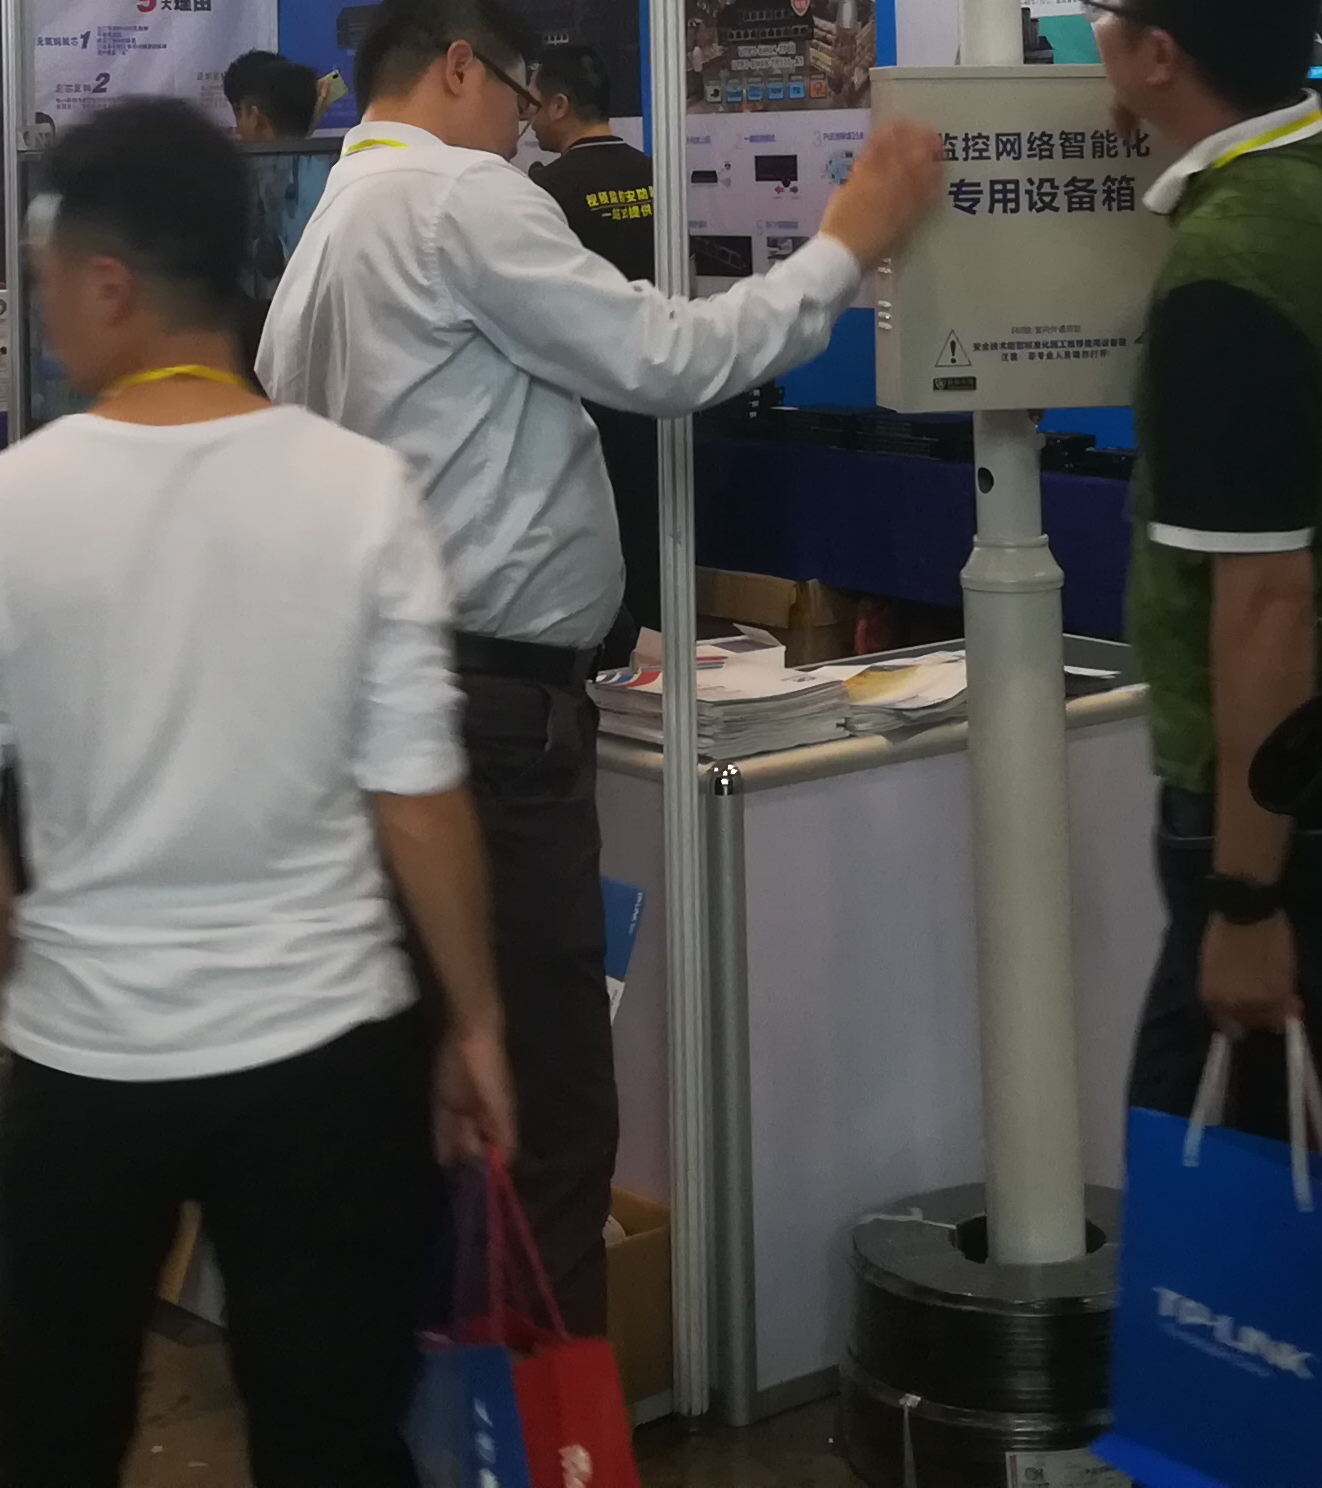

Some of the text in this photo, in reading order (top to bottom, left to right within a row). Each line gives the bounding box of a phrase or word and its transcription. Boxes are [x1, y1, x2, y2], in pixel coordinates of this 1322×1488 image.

[935, 128, 1151, 162] 监控网络智能化
[947, 174, 1137, 215] 专用设备箱
